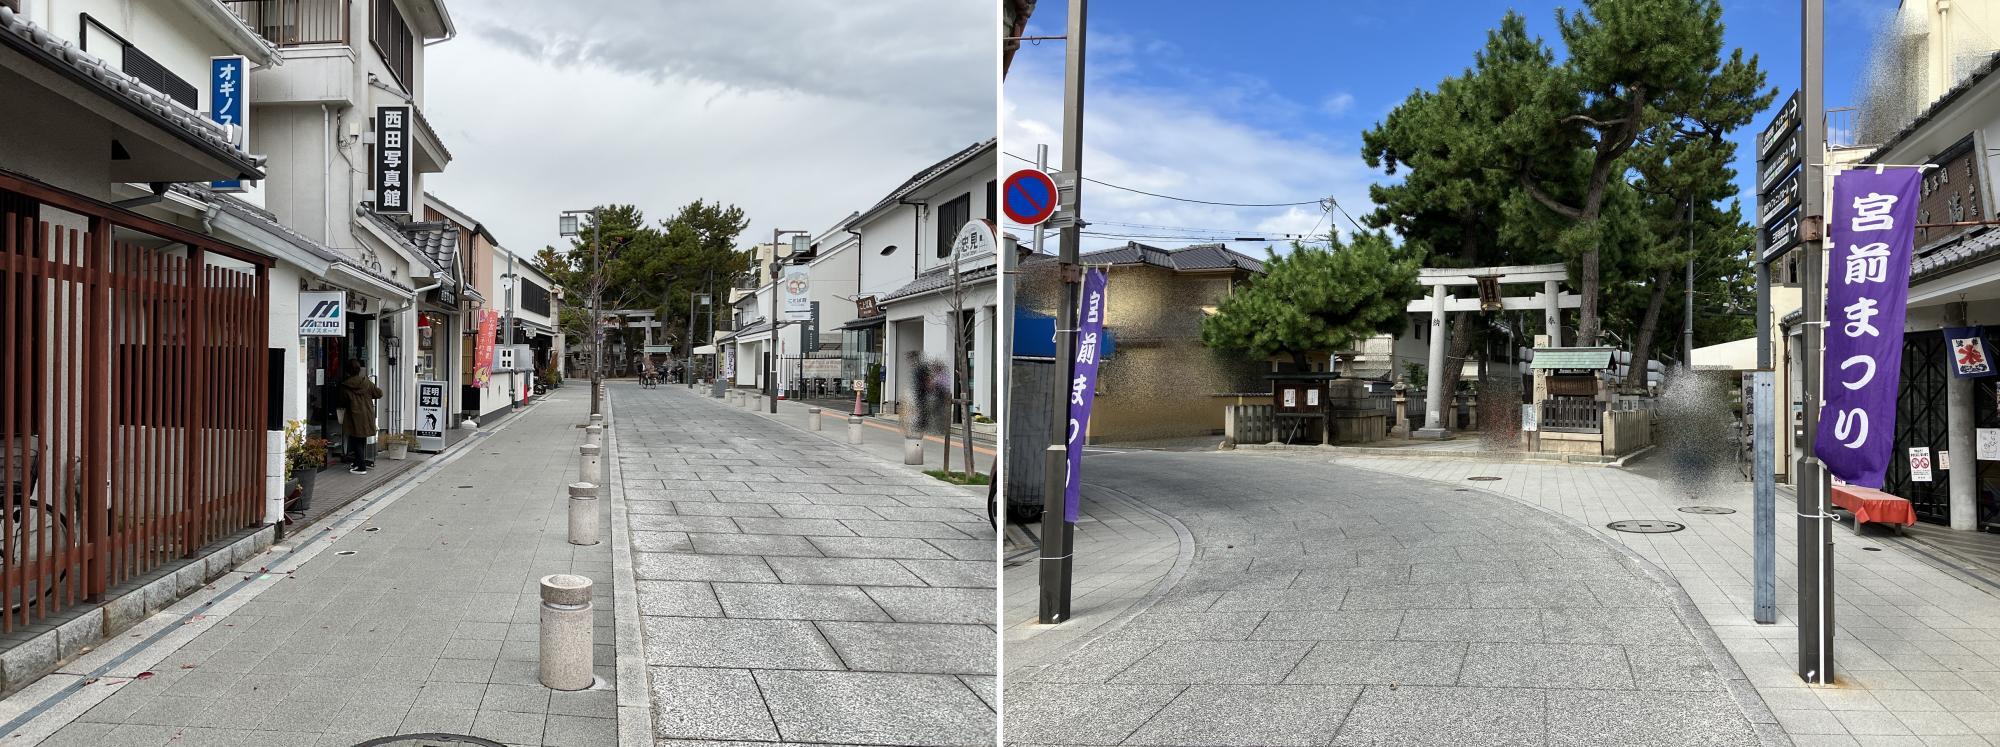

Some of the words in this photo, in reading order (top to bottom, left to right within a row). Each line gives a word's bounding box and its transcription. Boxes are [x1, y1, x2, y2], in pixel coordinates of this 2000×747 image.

[219, 64, 236, 126] オギノス
[383, 110, 402, 207] 西田写真館
[1922, 167, 1949, 197] 菓子司
[1834, 192, 1898, 449] 宮前まつり
[1958, 344, 1984, 365] 氷
[422, 386, 440, 396] 証明
[422, 396, 440, 406] 写真
